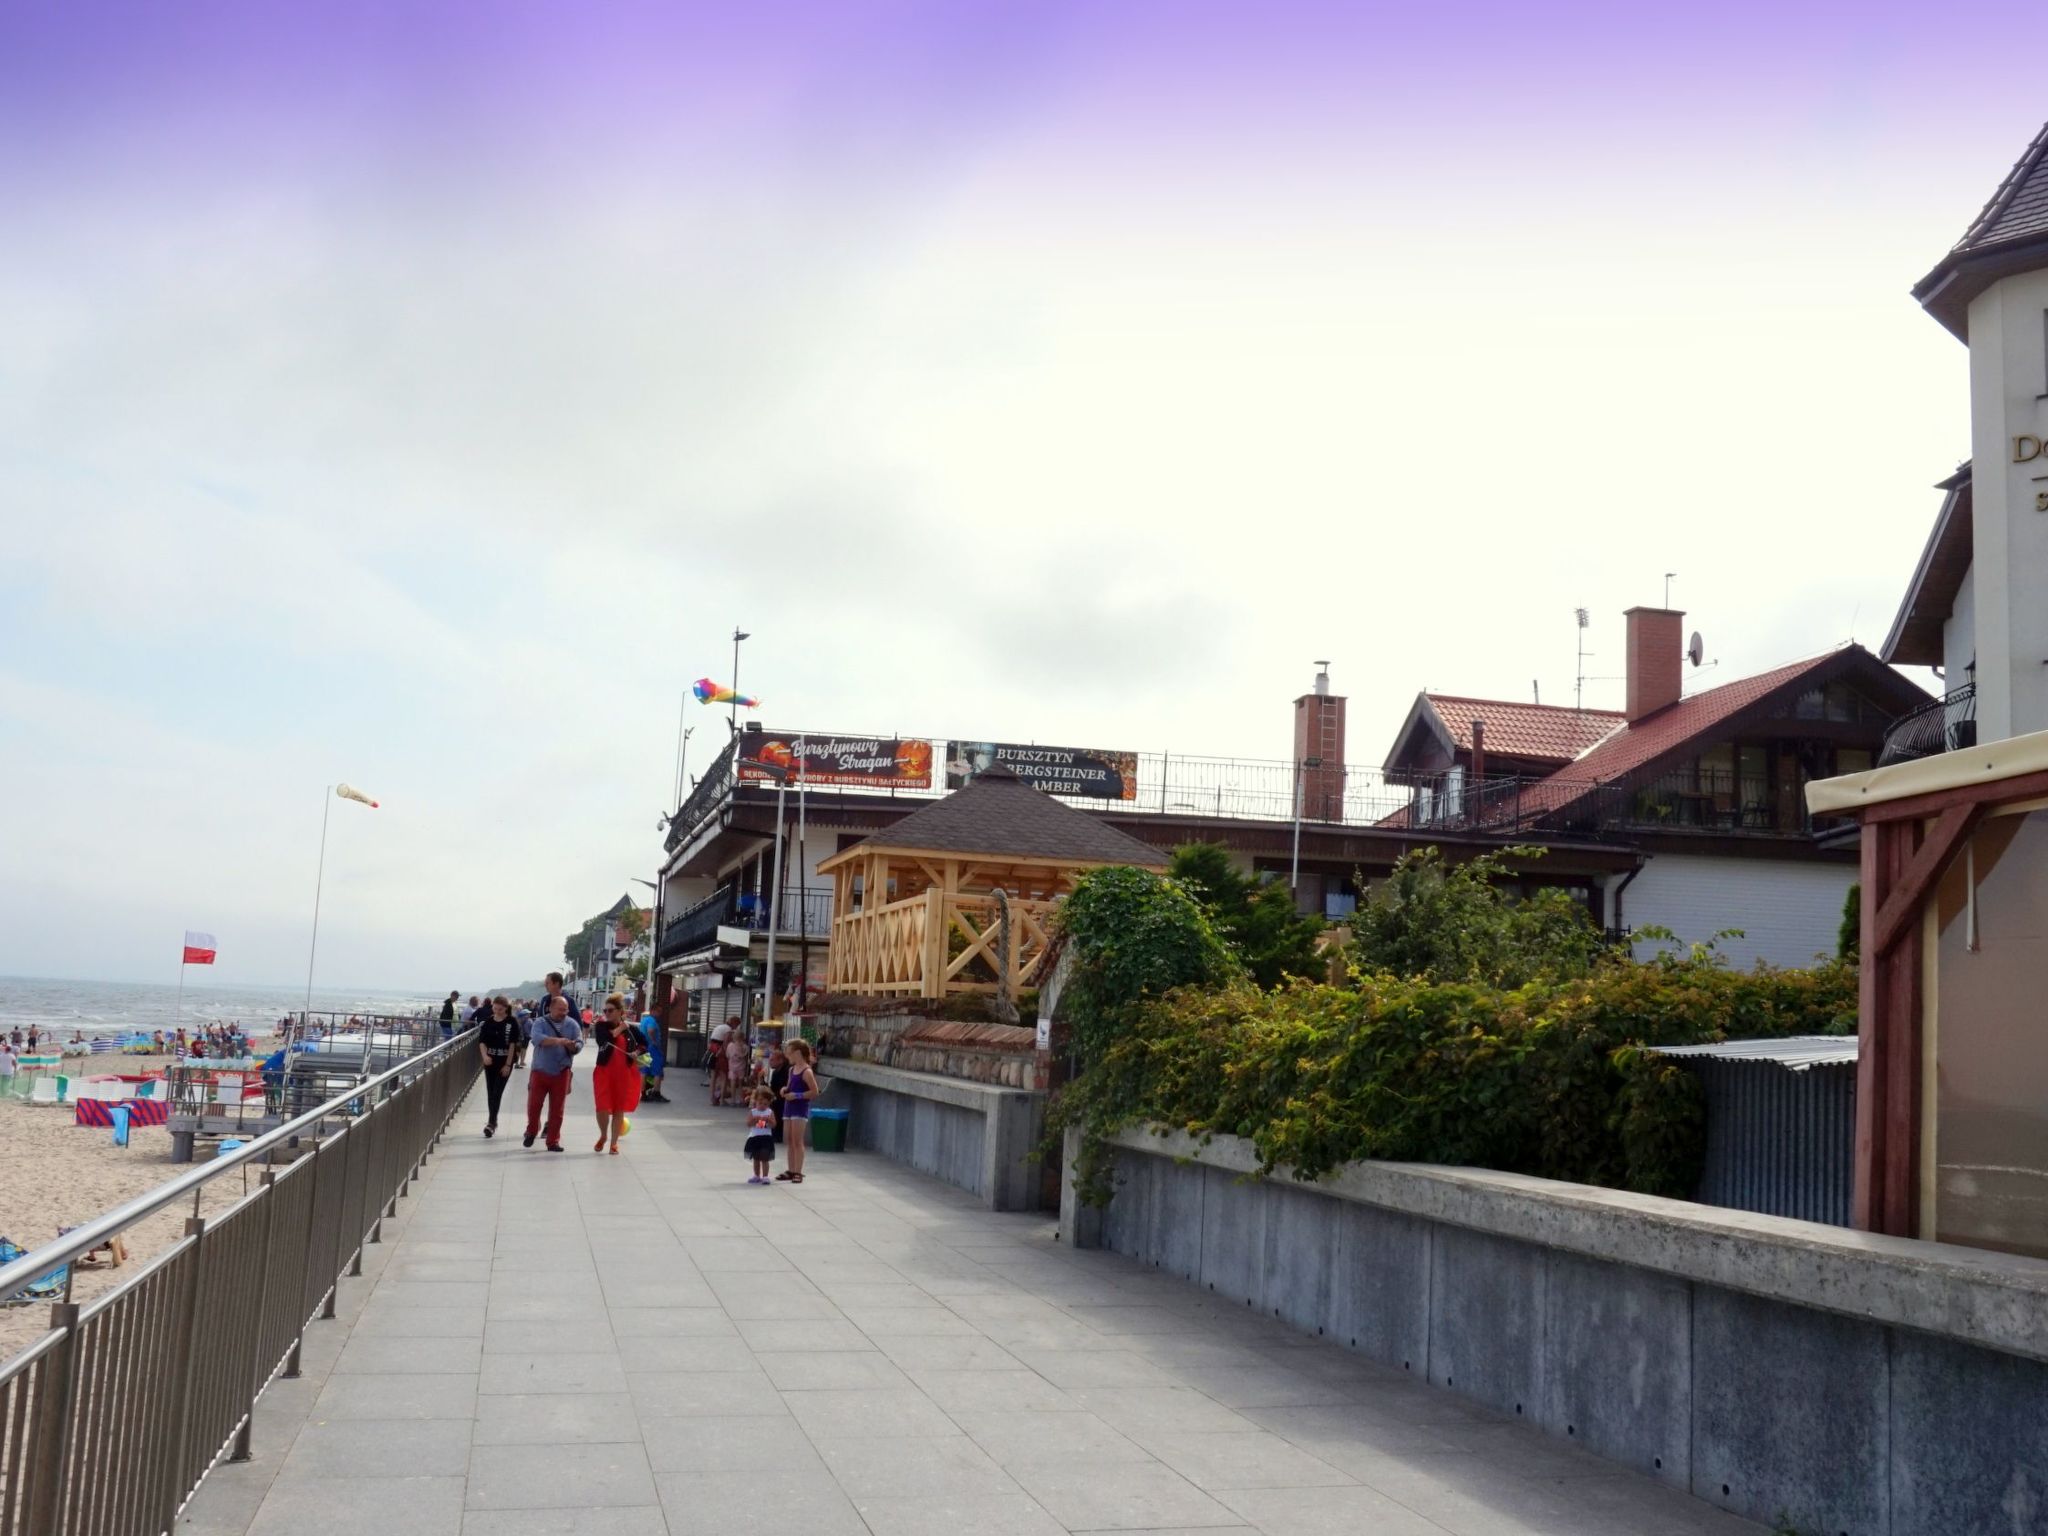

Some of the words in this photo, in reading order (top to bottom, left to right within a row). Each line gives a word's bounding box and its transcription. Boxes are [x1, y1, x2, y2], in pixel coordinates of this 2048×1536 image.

[2012, 434, 2048, 463] D
[791, 739, 880, 760] Bursztynowy
[997, 748, 1074, 763] BURSZTYN
[838, 754, 893, 773] Stragan
[1032, 780, 1081, 793] AMBER
